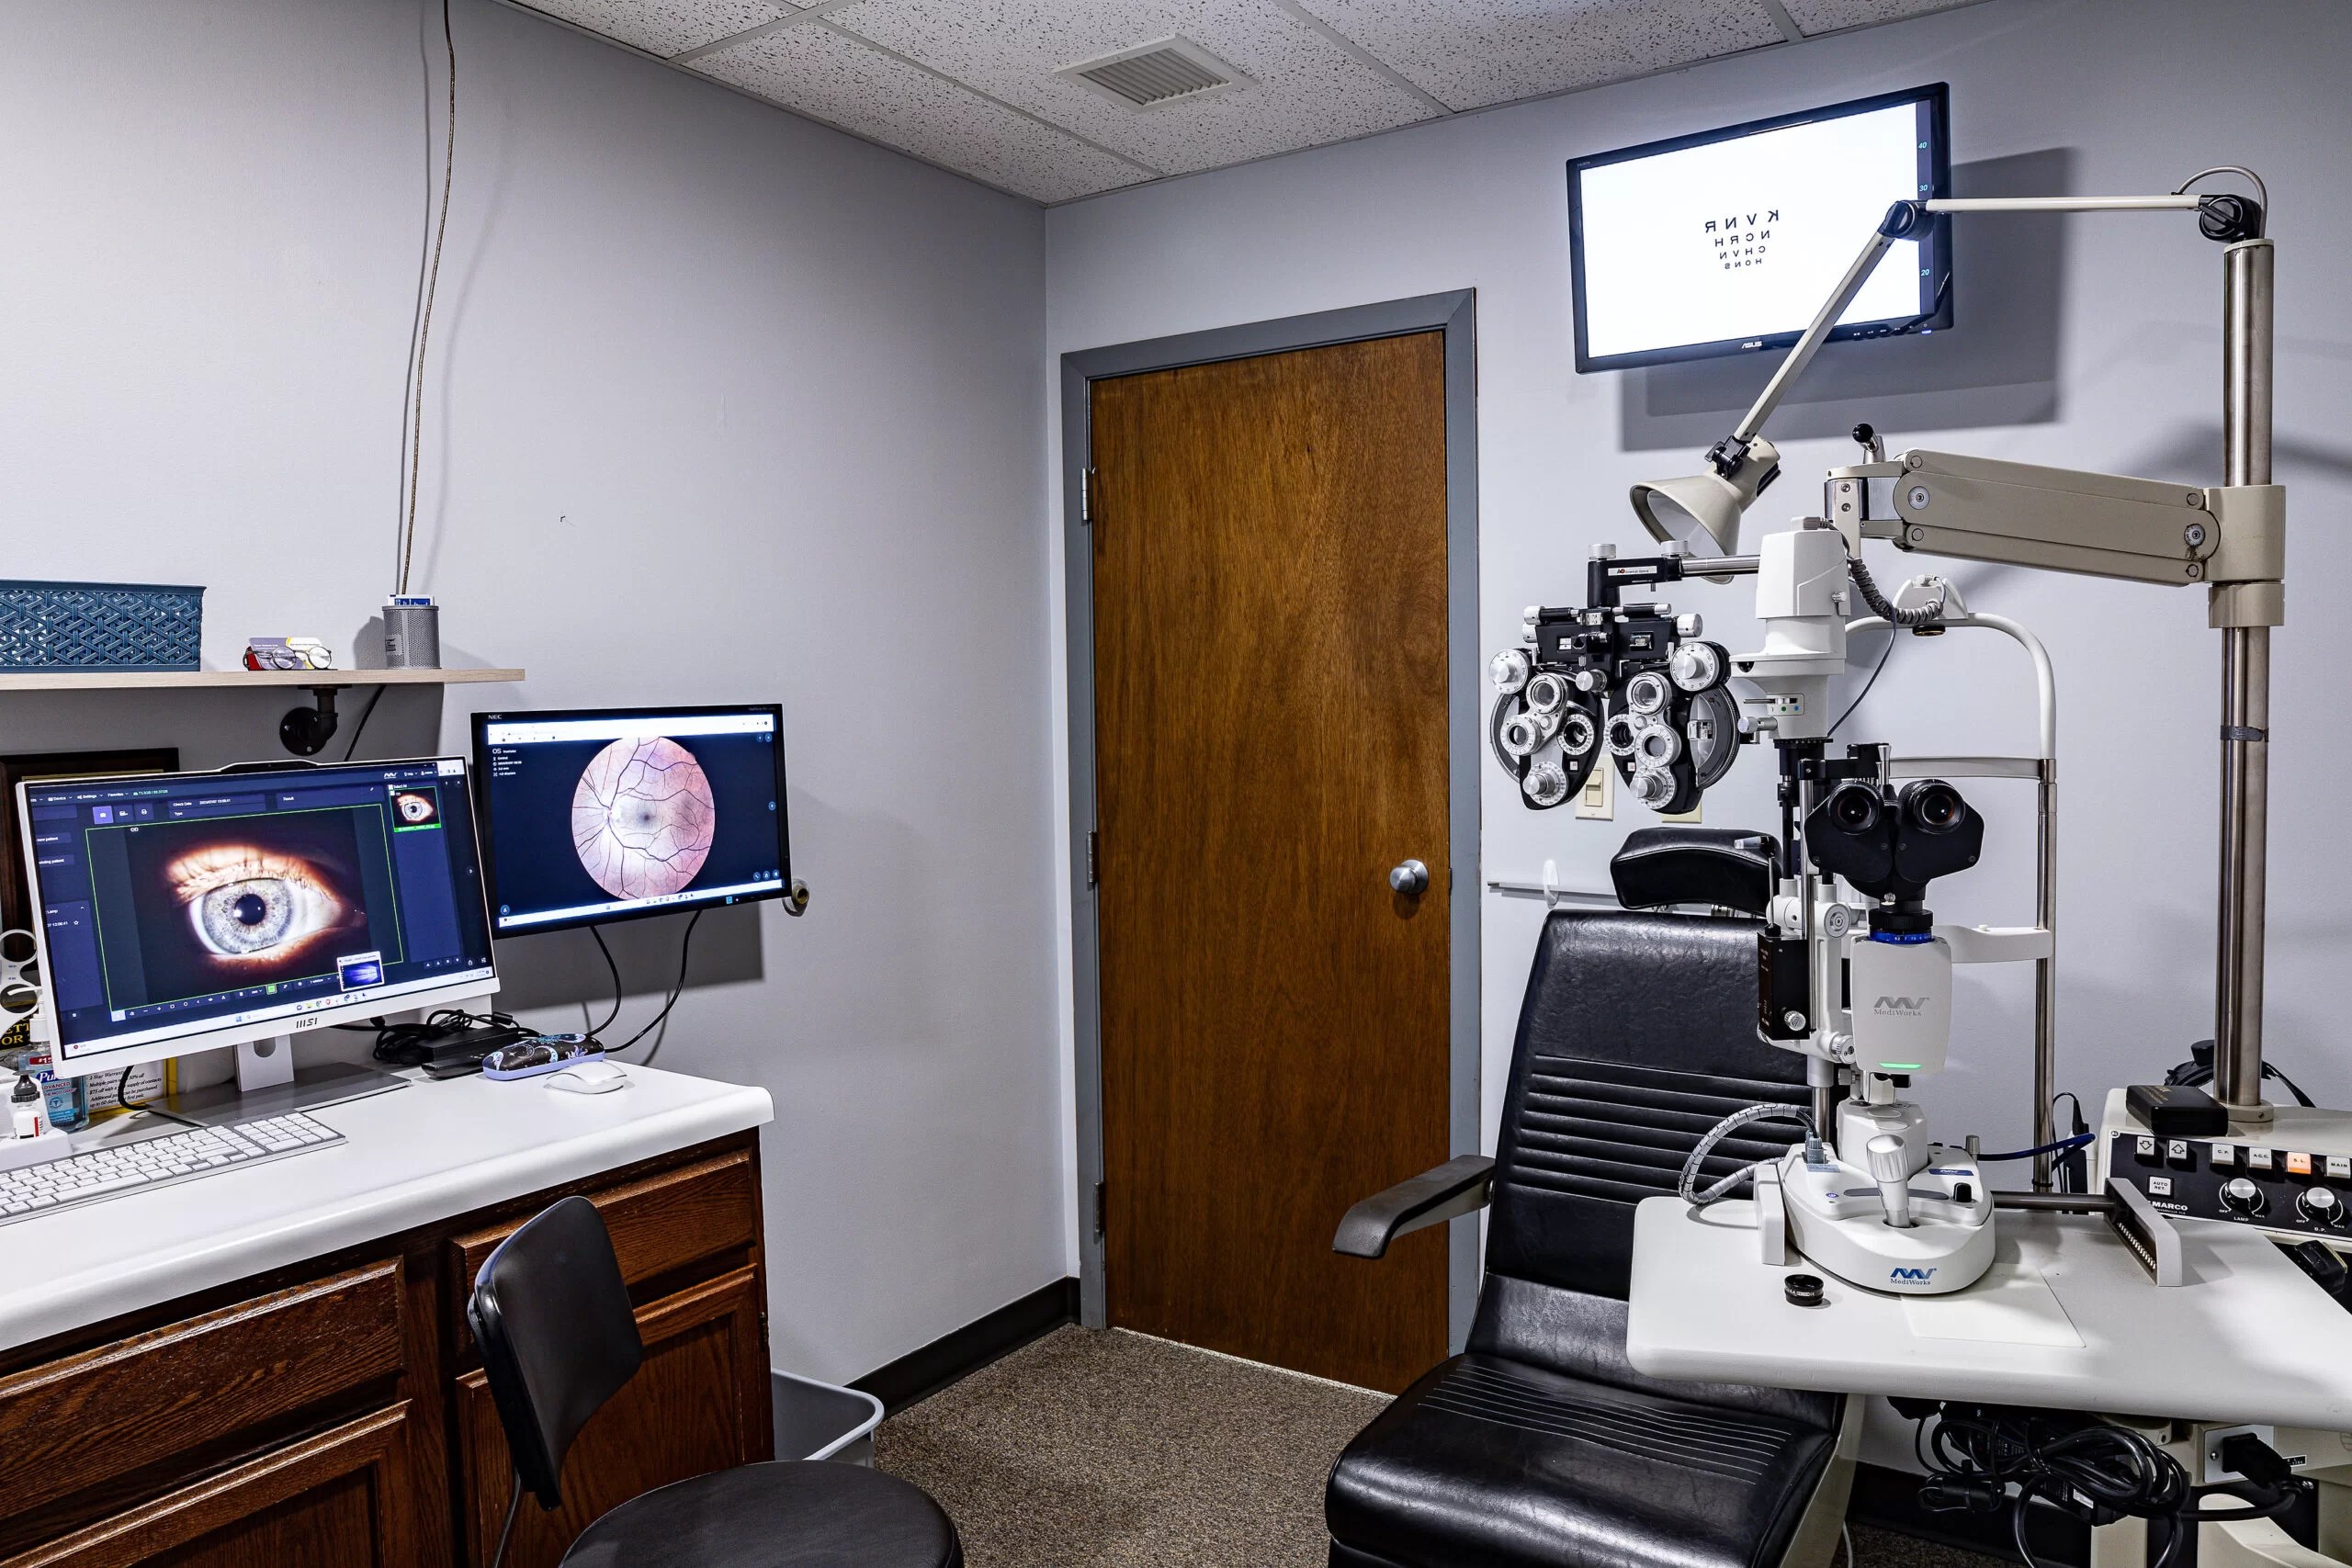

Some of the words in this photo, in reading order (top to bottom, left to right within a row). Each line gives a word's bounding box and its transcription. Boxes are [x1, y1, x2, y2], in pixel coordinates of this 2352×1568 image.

[1920, 268, 1929, 276] 20
[1741, 341, 1762, 349] ASUS
[296, 1017, 318, 1029] MSI
[43, 1081, 71, 1090] DVANCED
[2152, 1201, 2188, 1211] MARCO
